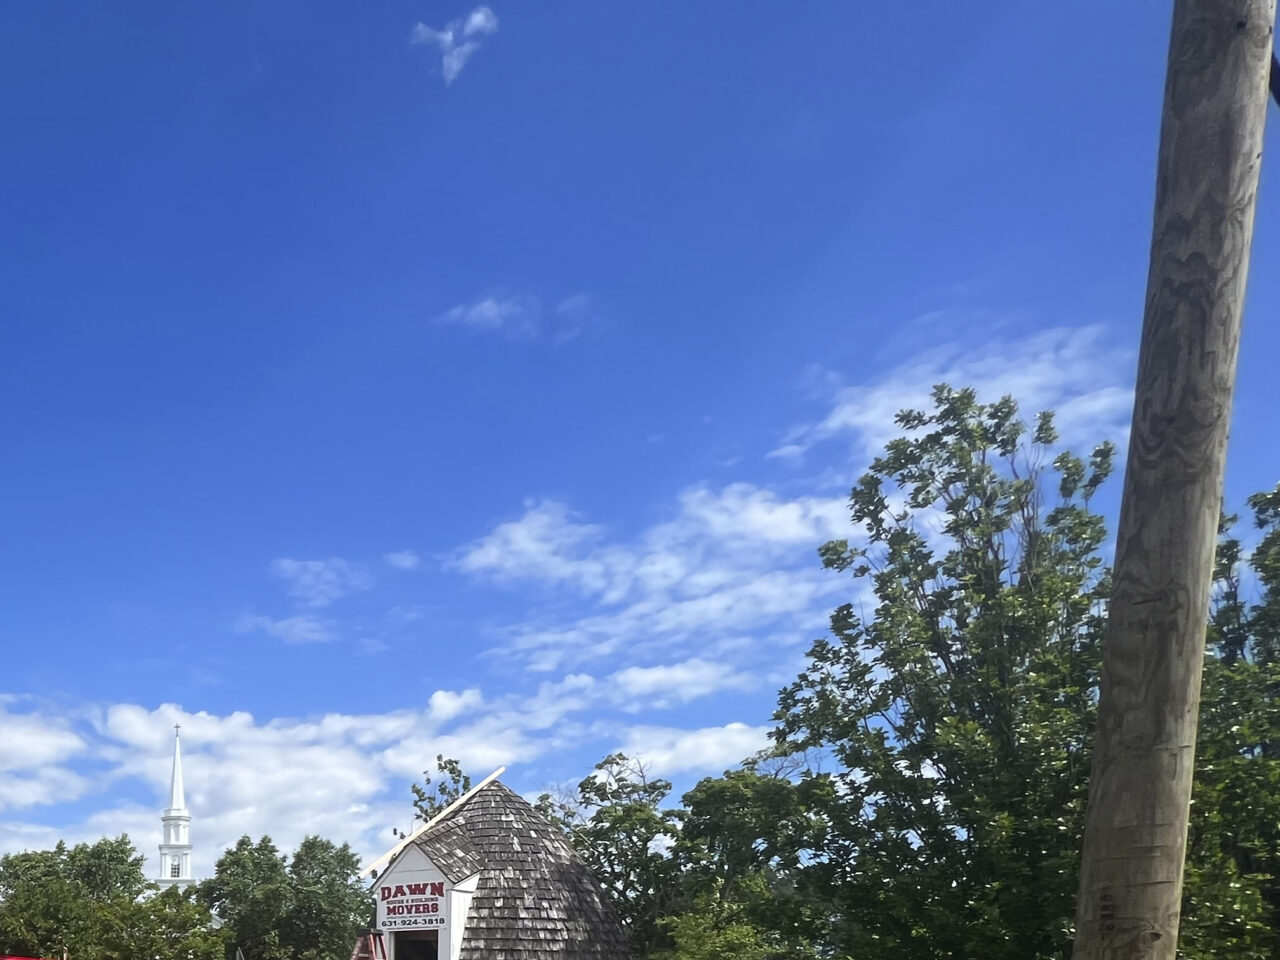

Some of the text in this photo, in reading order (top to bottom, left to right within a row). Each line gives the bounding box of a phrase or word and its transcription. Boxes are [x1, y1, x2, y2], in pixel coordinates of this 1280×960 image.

[381, 882, 445, 901] DAWN
[387, 903, 439, 915] MOVERS
[382, 918, 445, 927] 631-924-3818
